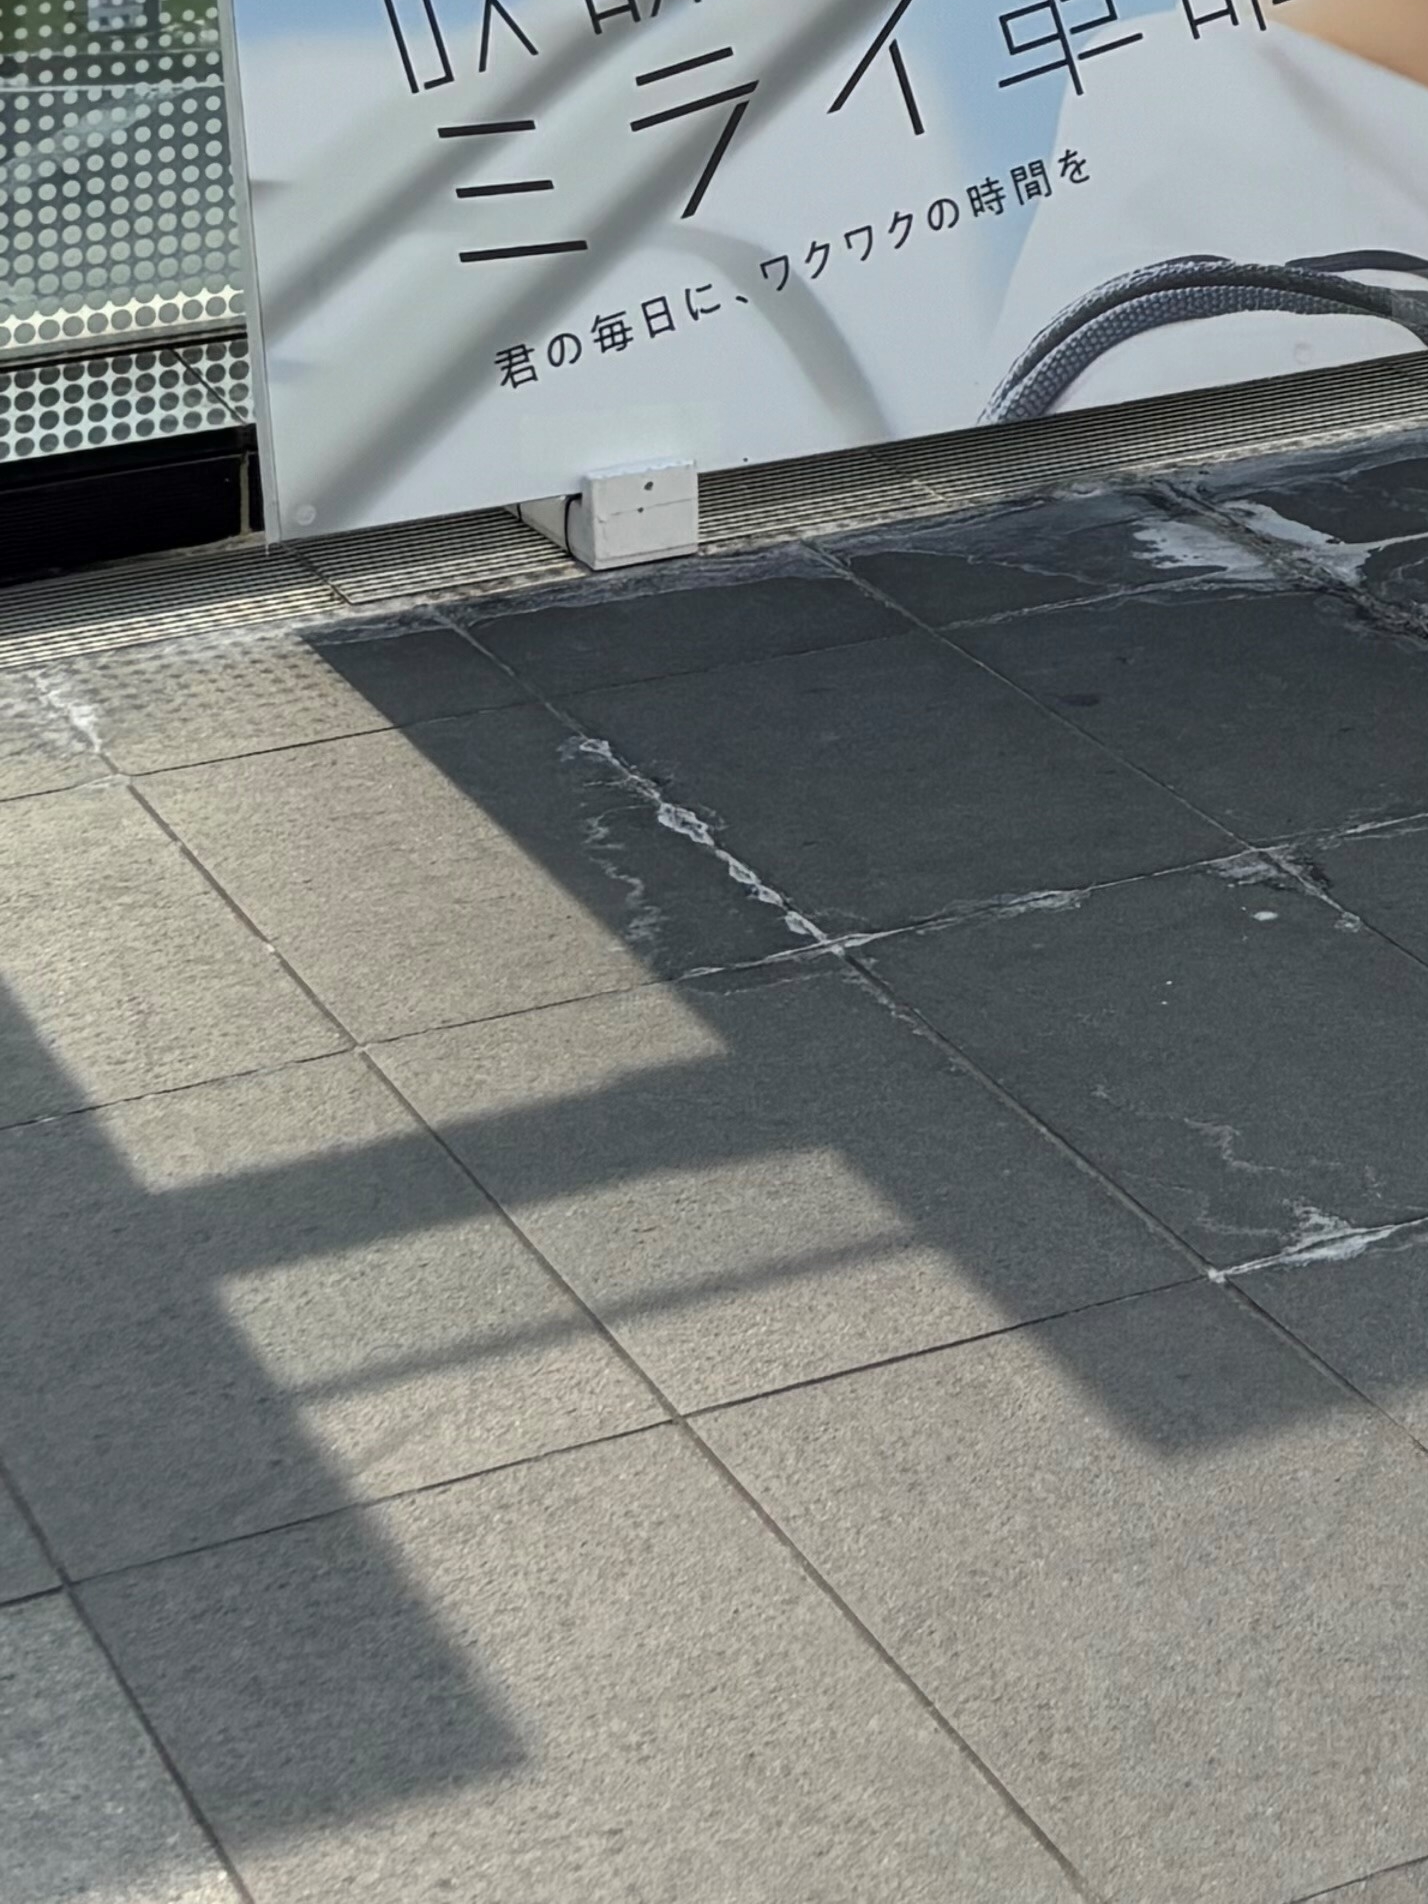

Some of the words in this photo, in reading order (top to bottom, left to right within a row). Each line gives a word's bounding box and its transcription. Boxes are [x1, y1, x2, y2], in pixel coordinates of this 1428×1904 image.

[493, 149, 1093, 390] 君の毎日に、ワクワクの時間を
